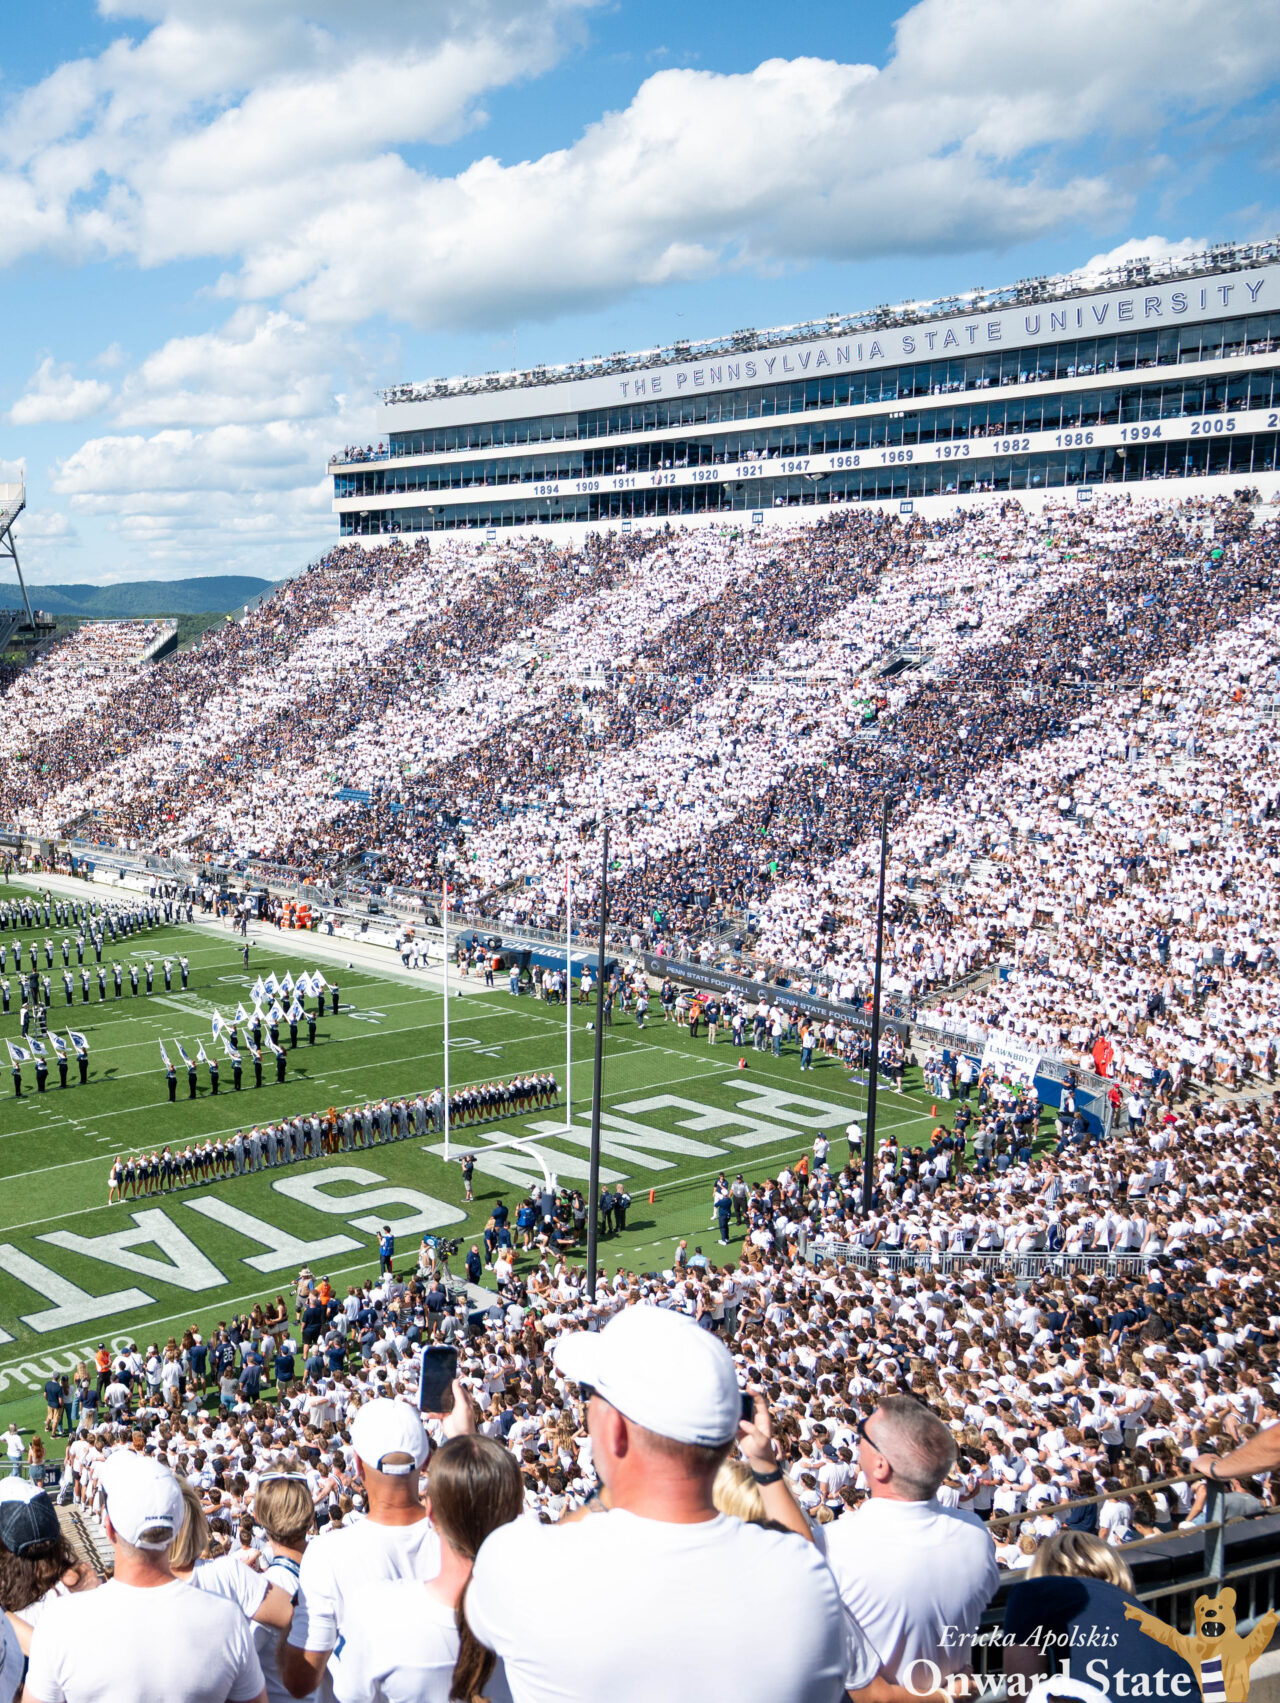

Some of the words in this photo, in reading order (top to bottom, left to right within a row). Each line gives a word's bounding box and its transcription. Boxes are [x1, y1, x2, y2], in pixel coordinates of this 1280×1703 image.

[620, 375, 662, 398] THE
[676, 339, 884, 390] PENNSYLVANIA
[901, 320, 1002, 355] STATE
[1024, 278, 1265, 335] UNIVERSITY
[533, 484, 560, 496] 1894
[576, 481, 600, 492] 1909
[612, 477, 636, 489] 1911
[692, 469, 719, 482] 1920
[735, 465, 763, 477] 1921
[780, 460, 811, 473] 1947
[828, 454, 861, 469] 1968
[880, 448, 914, 464] 1969
[934, 443, 971, 459] 1973
[992, 438, 1031, 454] 1982
[1055, 431, 1095, 448] 1986
[1120, 424, 1162, 442] 1994
[1190, 417, 1236, 436] 2005
[666, 965, 685, 978] PENN
[686, 970, 709, 984] STATE
[710, 974, 750, 995] FOOTBALL
[775, 996, 798, 1008] PENN
[798, 1001, 827, 1016] STATE
[989, 1045, 1035, 1065] LAWNBOYZ
[421, 1078, 870, 1192] PENN
